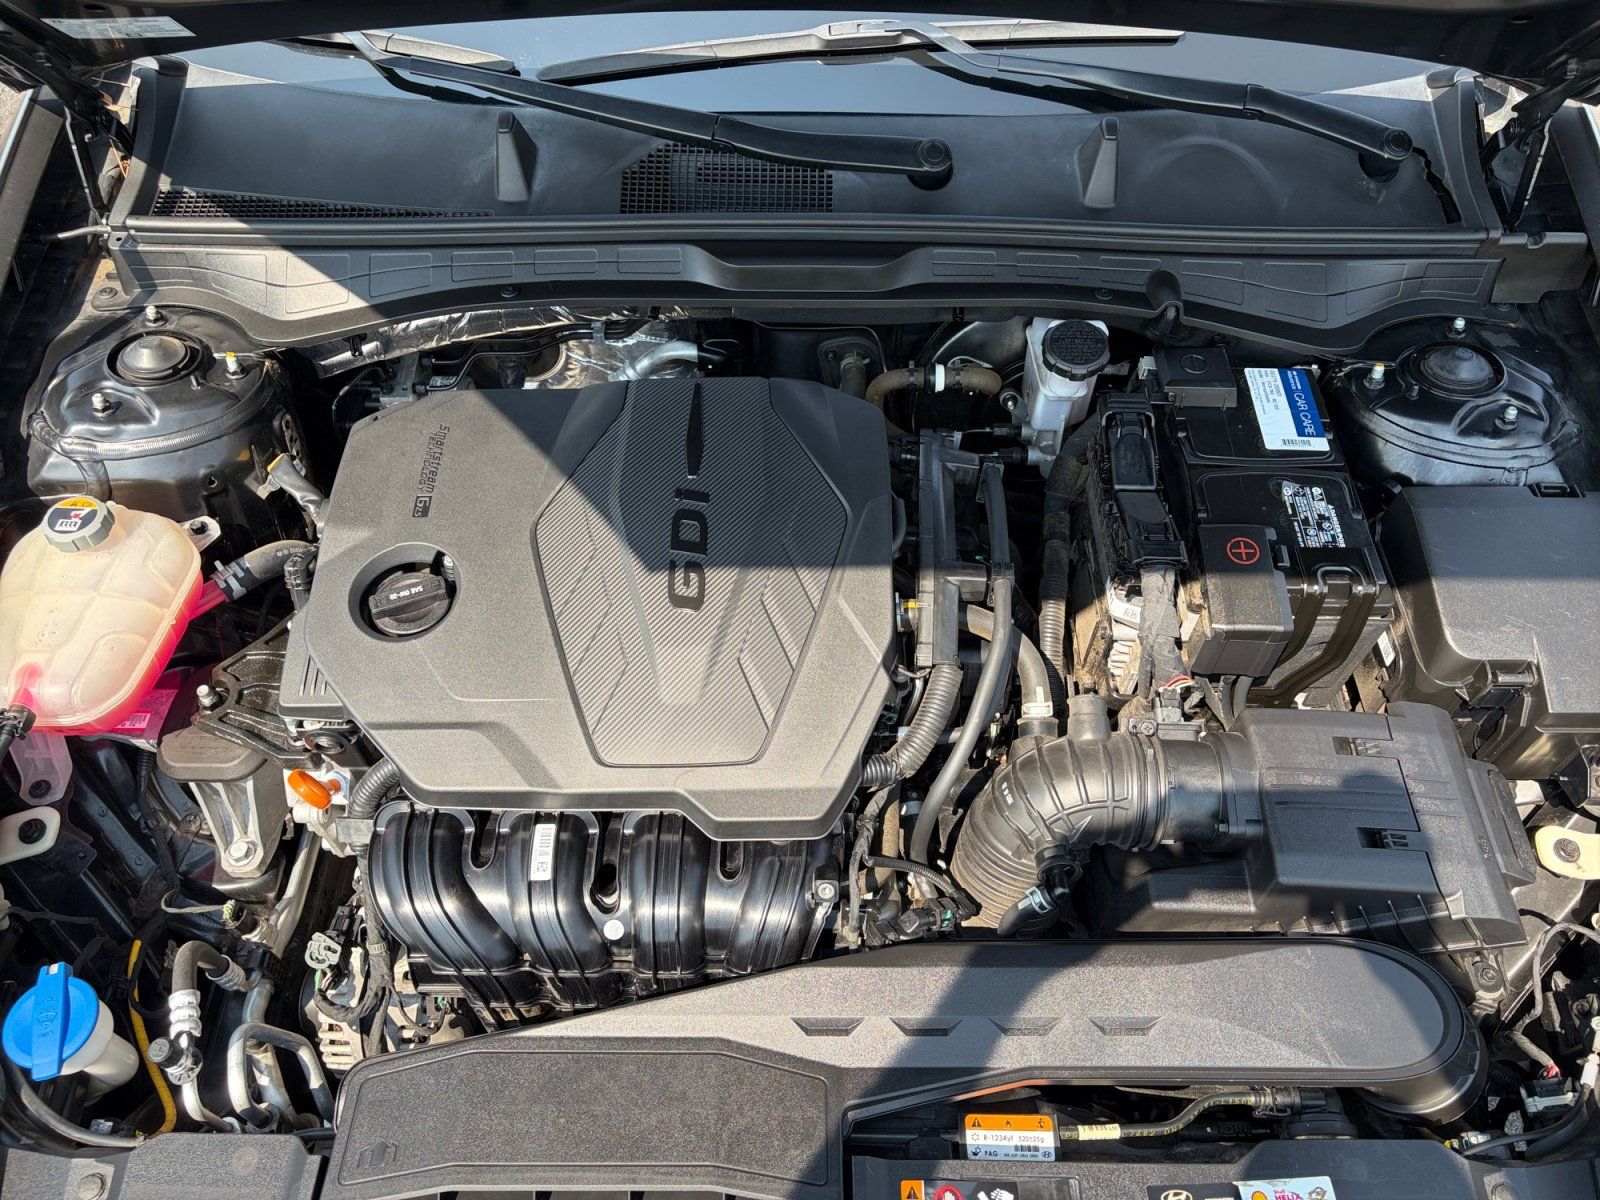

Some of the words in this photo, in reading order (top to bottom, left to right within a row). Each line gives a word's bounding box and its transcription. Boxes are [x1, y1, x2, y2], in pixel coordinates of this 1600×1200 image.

[1294, 392, 1308, 411] CAR
[1300, 412, 1316, 436] CARE
[418, 431, 438, 493] TECHNOLOGY
[425, 423, 450, 494] Smartstream
[390, 589, 410, 600] 0W-20
[410, 585, 423, 594] SAE
[983, 1134, 1014, 1143] R-1234yf
[1018, 1135, 1045, 1144] 520±25g
